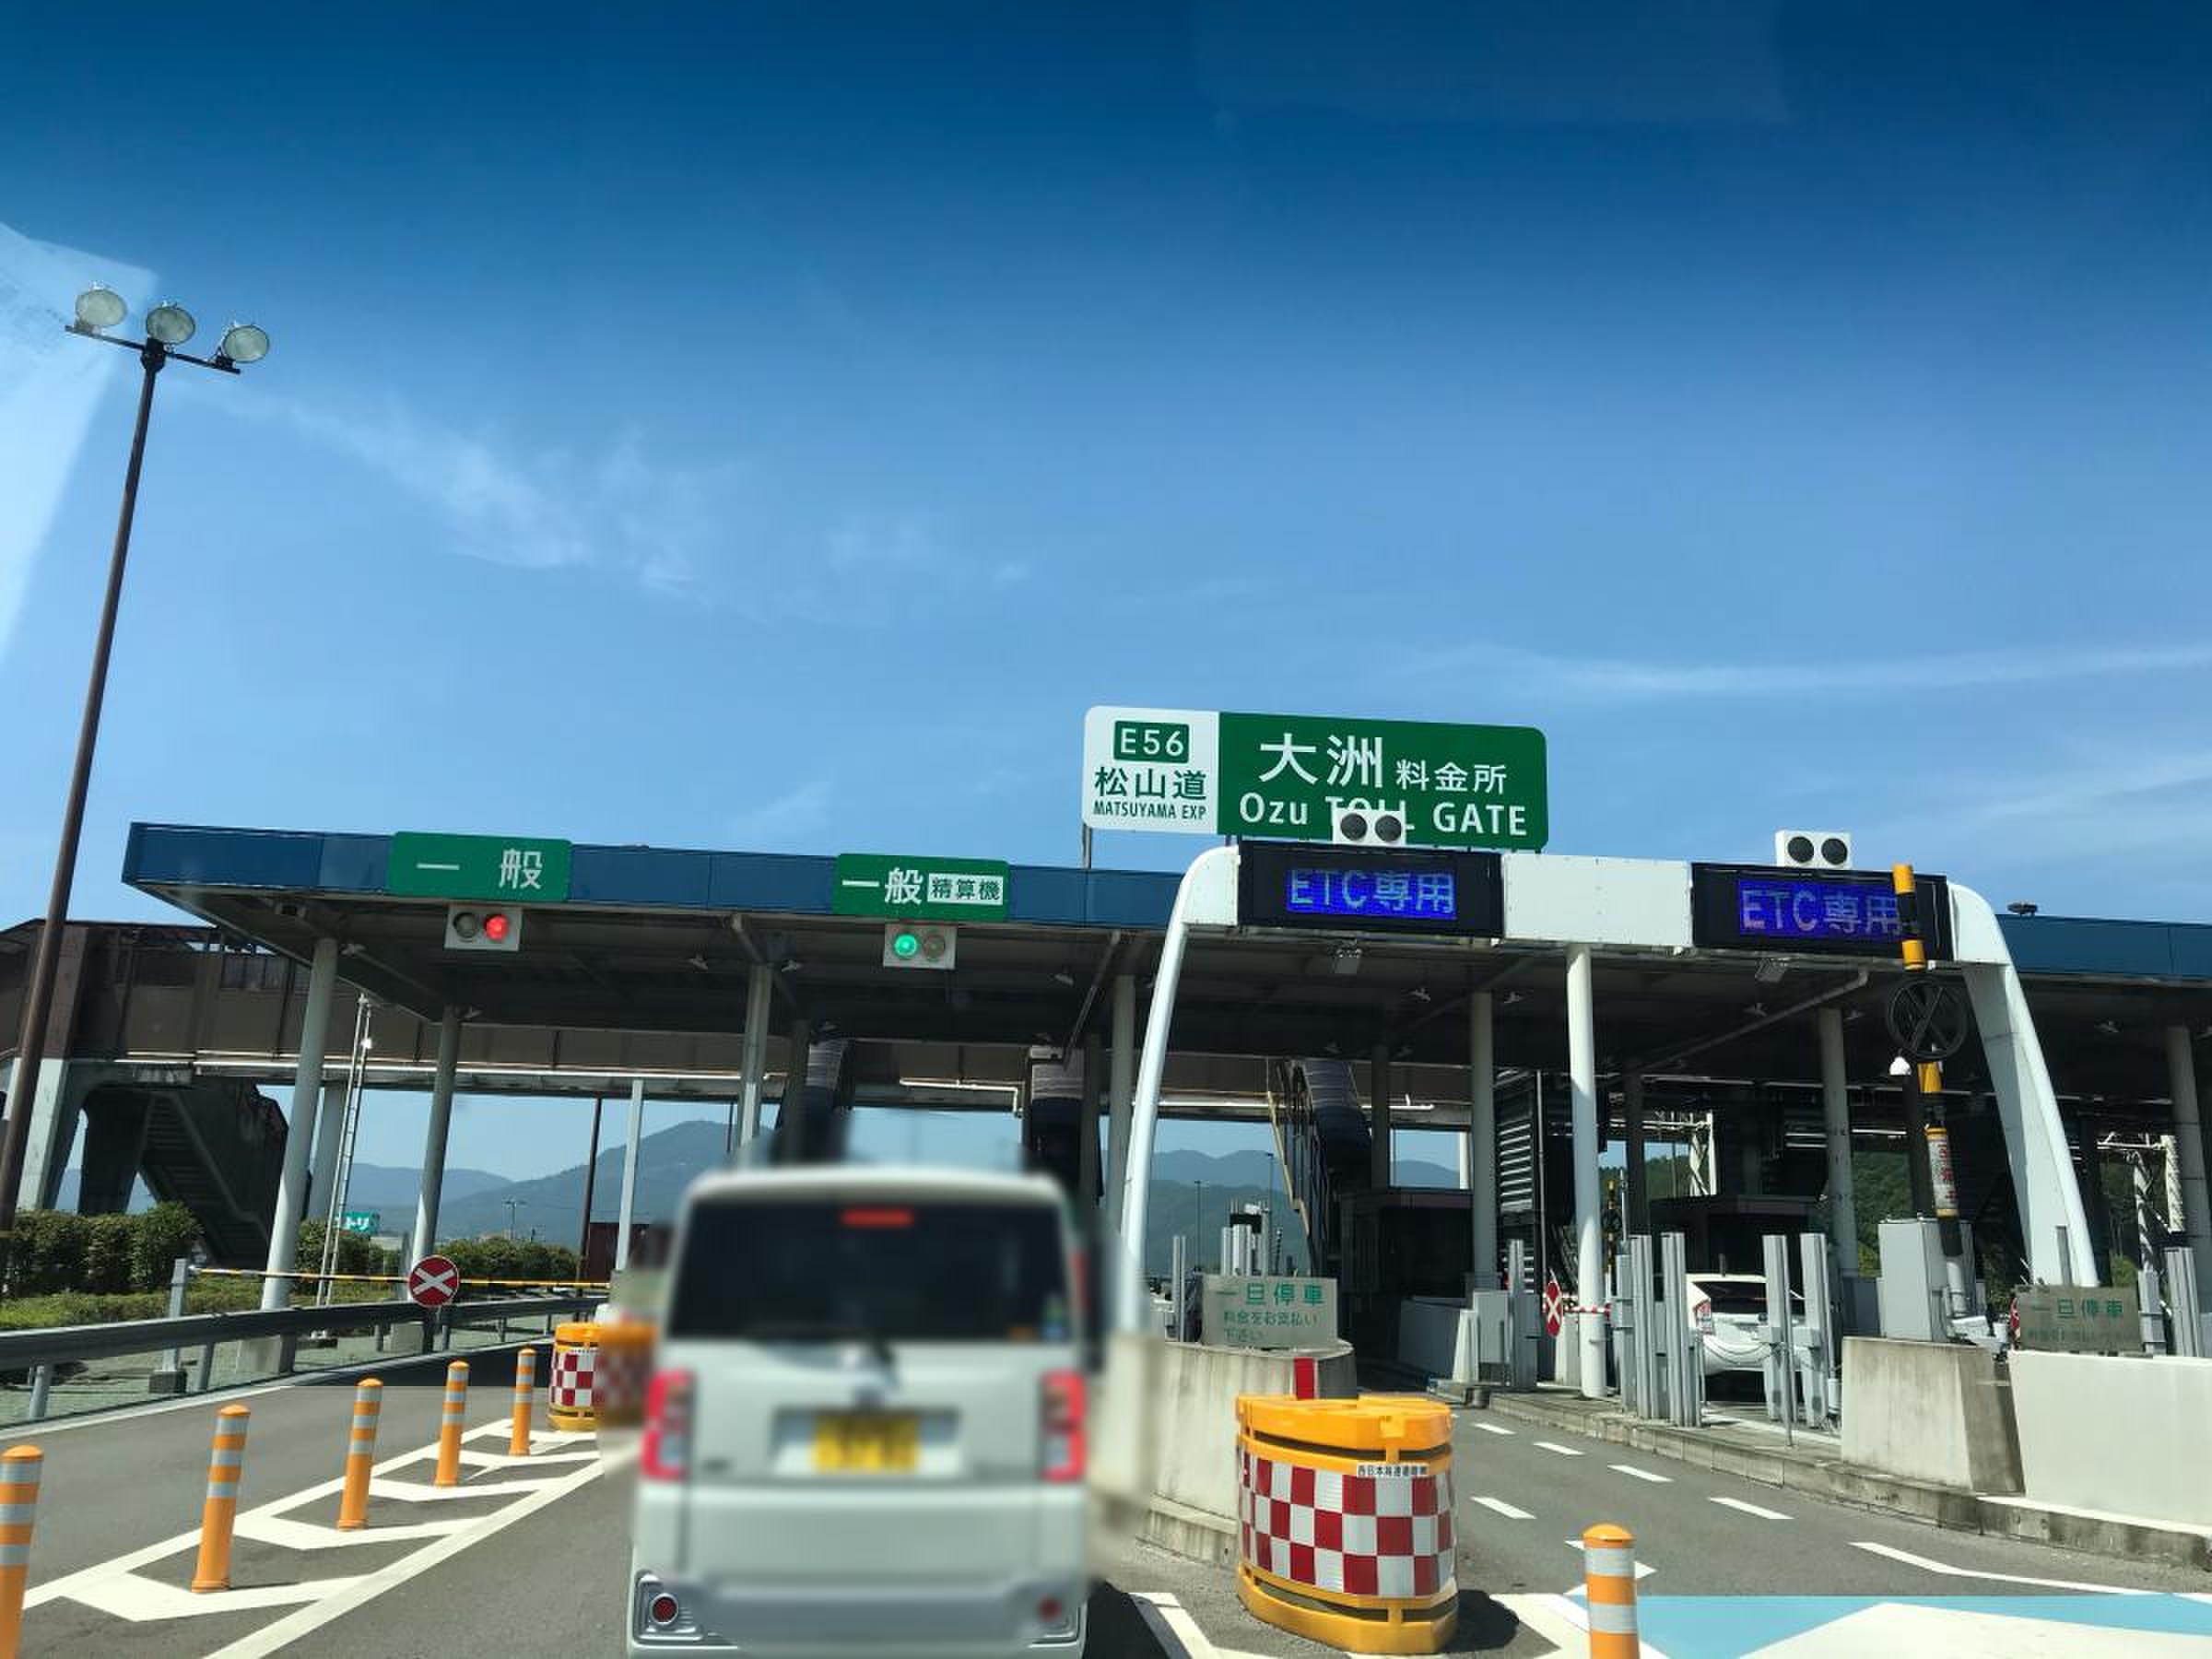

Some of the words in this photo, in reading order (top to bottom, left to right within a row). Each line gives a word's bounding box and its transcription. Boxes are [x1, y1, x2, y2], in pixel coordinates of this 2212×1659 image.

[1121, 727, 1184, 756] E56
[1259, 733, 1382, 788] 大洲
[1395, 759, 1507, 794] 料金所
[1094, 766, 1206, 800] 松山道
[1093, 800, 1177, 819] MATSUYAMA
[1182, 805, 1206, 819] EXP
[1240, 793, 1307, 825] Ozu
[1433, 802, 1527, 836] GATE
[417, 848, 543, 889] 一般
[842, 867, 923, 904] 一般
[932, 878, 1000, 900] 精算機
[1216, 1282, 1324, 1306] 一旦停車
